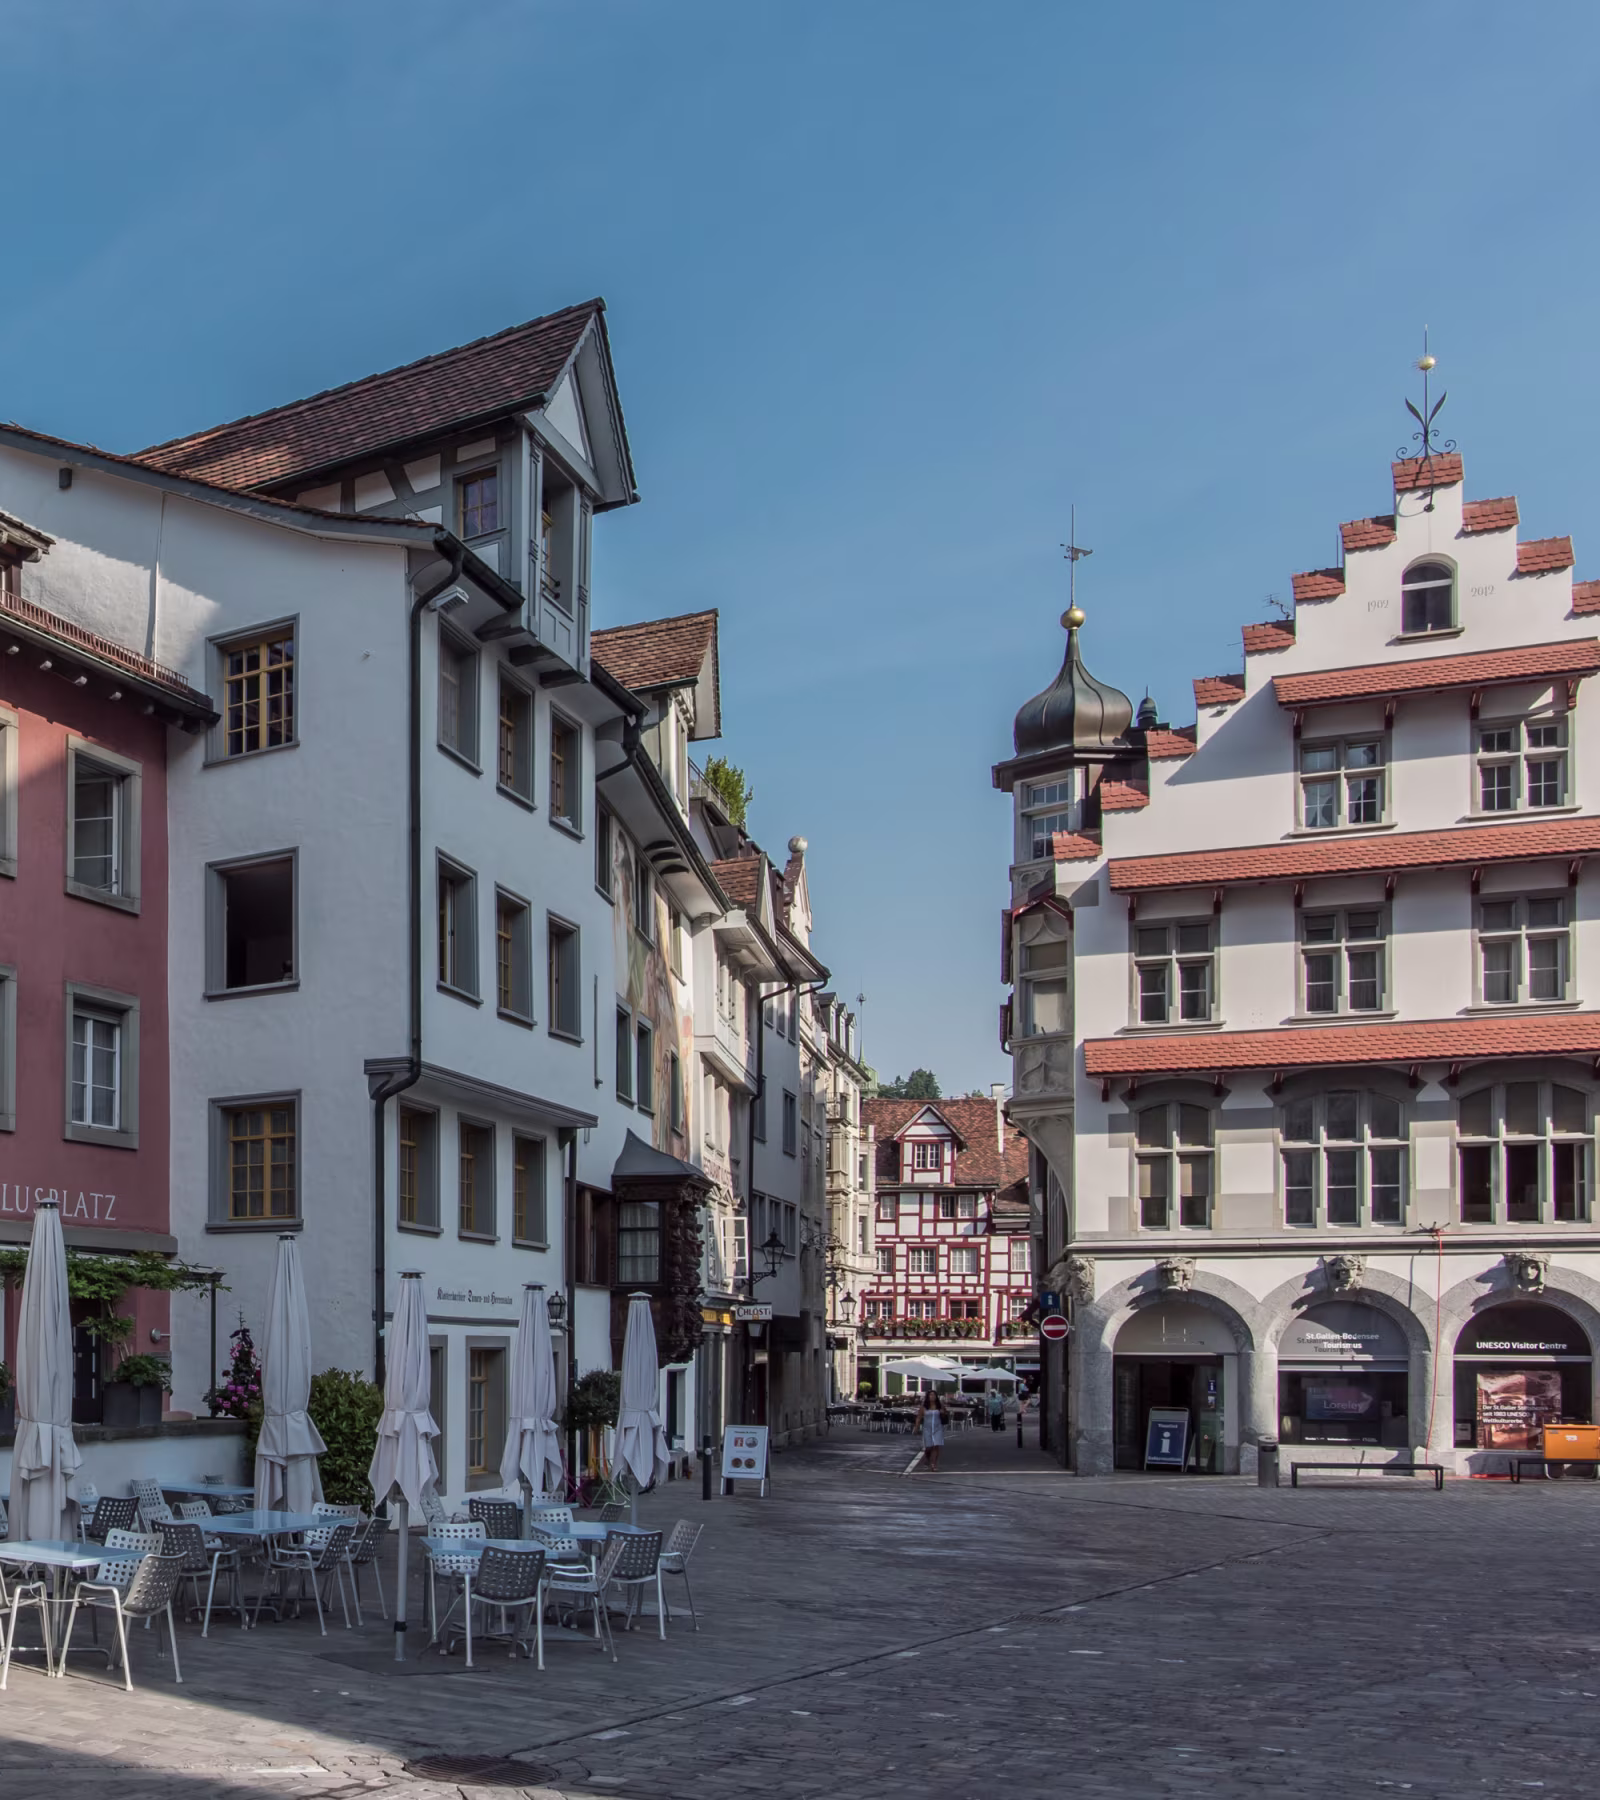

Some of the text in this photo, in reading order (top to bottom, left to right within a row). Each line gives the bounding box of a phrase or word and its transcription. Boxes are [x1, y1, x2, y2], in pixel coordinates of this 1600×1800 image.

[1323, 1341, 1363, 1349] Tourismus
[1476, 1341, 1510, 1349] UNESCO
[1511, 1341, 1538, 1349] Visitor
[1323, 1400, 1362, 1411] Loreley
